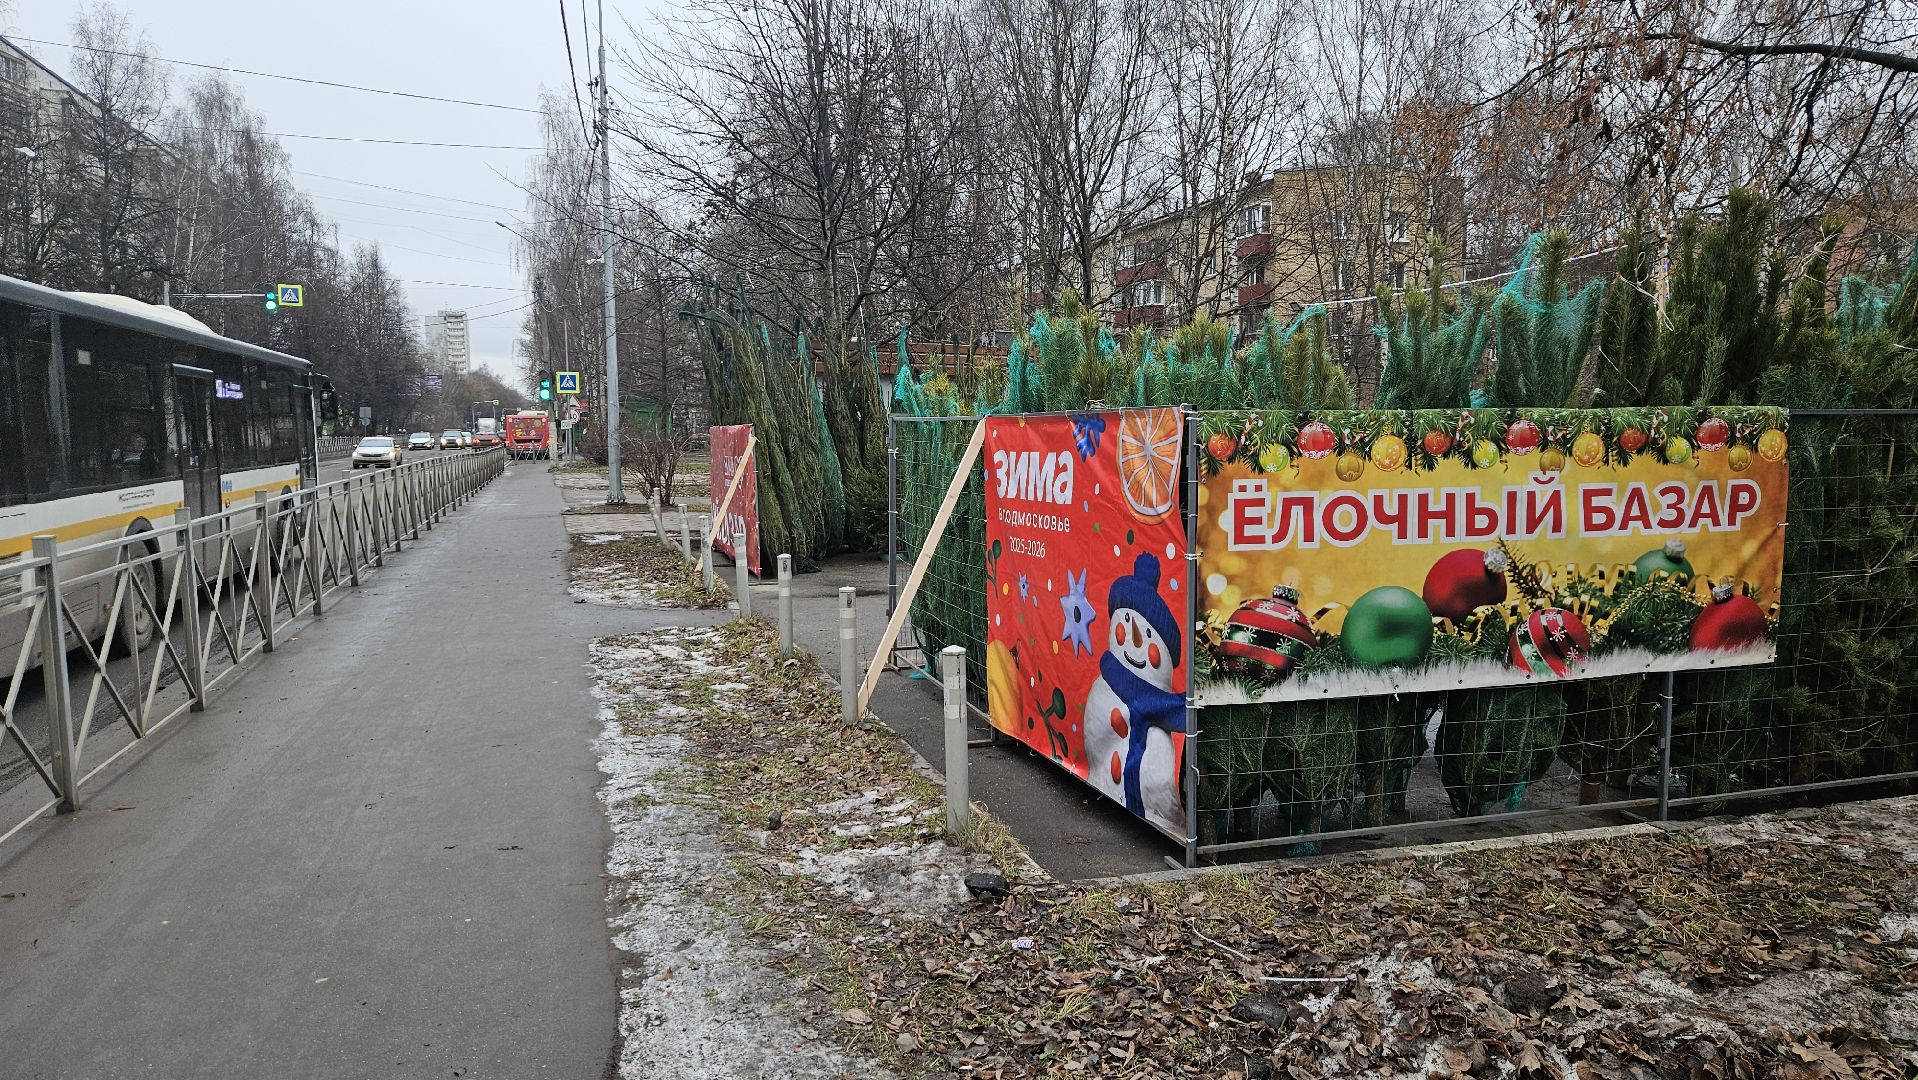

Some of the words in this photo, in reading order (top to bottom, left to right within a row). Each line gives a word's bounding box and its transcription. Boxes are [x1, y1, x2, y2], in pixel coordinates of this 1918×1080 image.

[1232, 475, 1564, 546] ЁЛОЧНЫЙ
[1581, 482, 1759, 533] БАЗАР
[1009, 536, 1046, 559] 2025-2026
